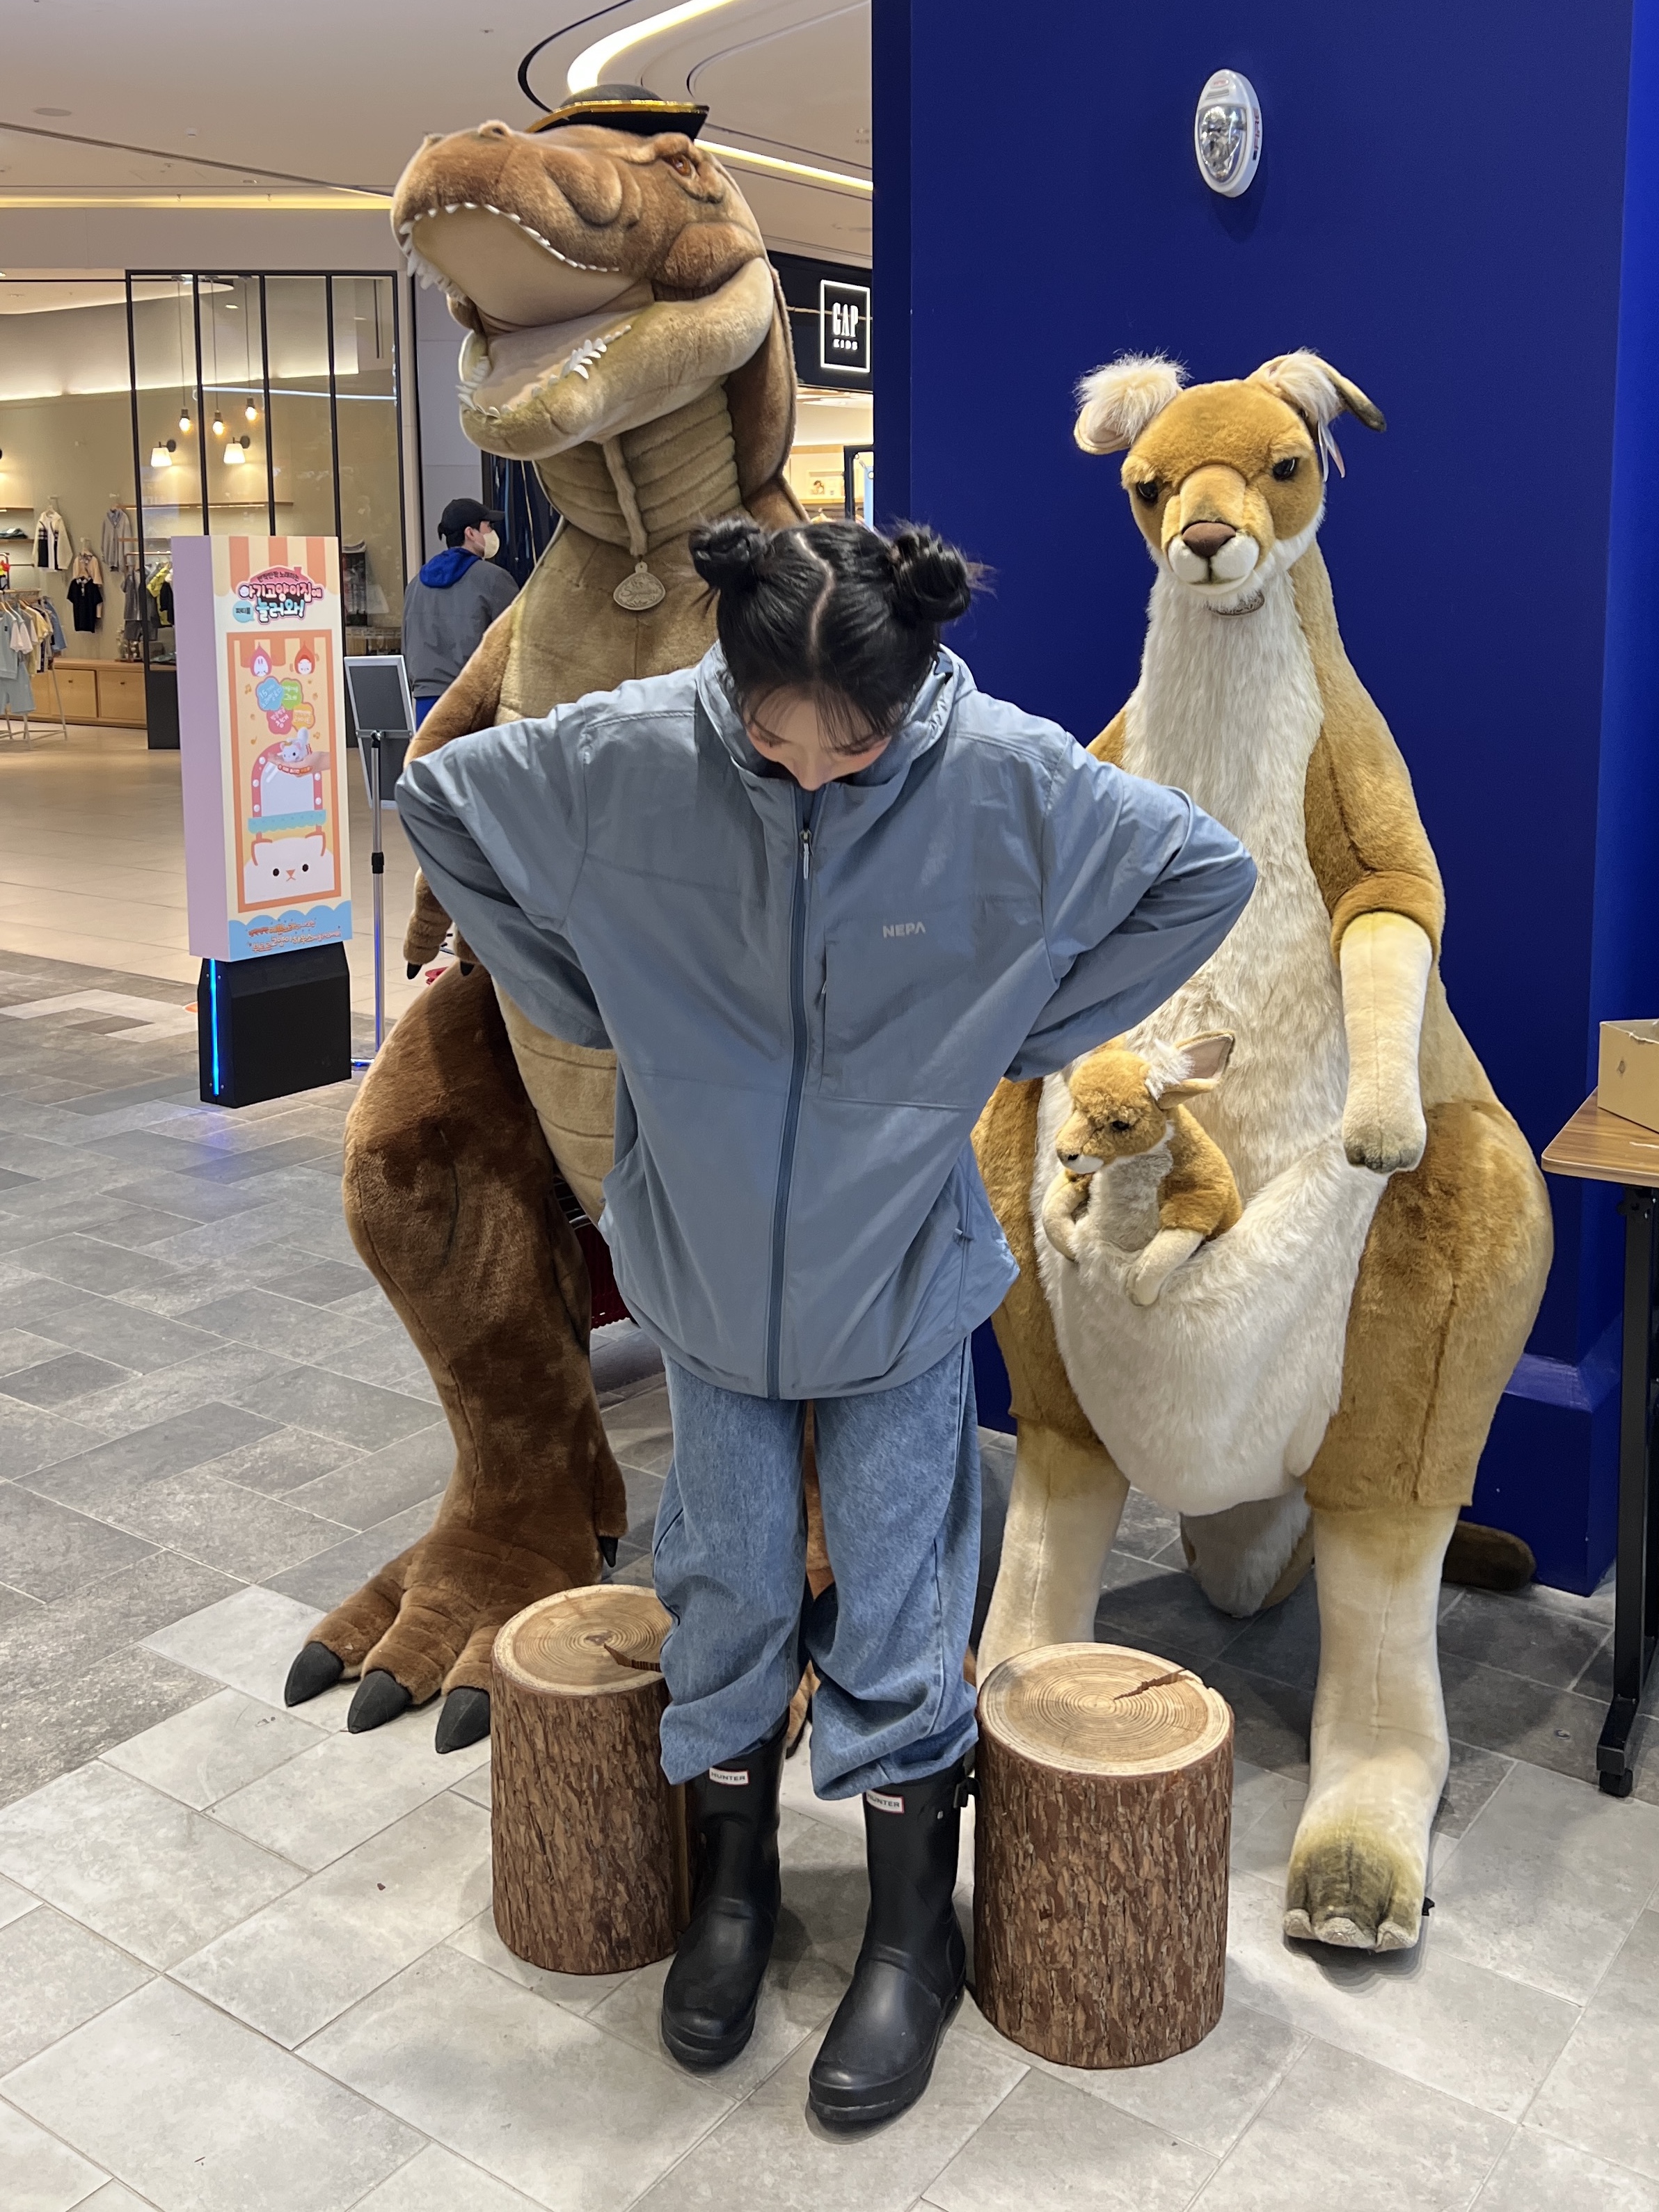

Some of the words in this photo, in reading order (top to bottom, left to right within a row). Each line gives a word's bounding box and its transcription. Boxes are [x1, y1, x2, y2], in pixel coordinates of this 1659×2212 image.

[832, 302, 859, 337] GAP
[239, 582, 323, 603] 아기고양이집에
[882, 921, 926, 939] NEPA
[711, 1772, 745, 1781] HUNTER
[868, 1793, 900, 1807] HUNTER
